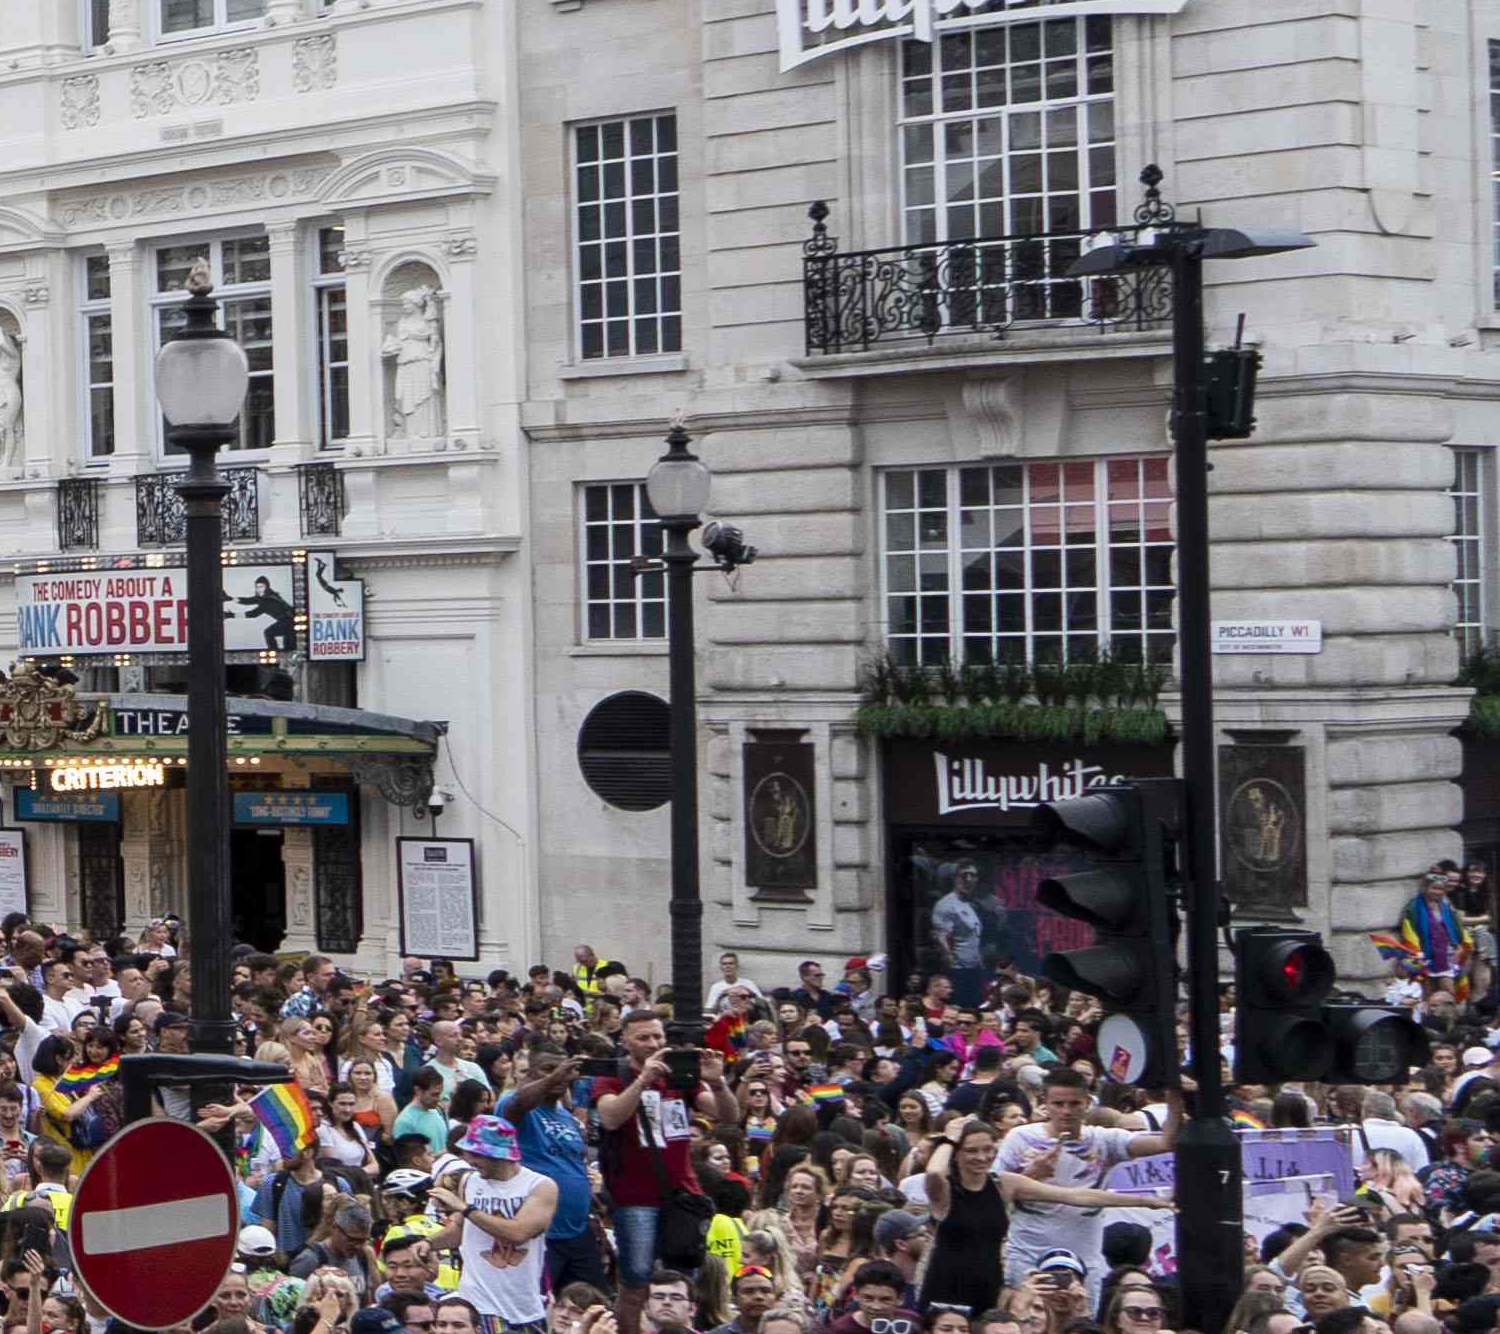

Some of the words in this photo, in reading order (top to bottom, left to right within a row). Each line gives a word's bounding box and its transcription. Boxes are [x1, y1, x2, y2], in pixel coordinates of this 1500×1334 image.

[32, 581, 49, 602] THE
[51, 579, 102, 600] COMEDY
[107, 577, 157, 599] ABOUT
[162, 575, 174, 597] A
[312, 618, 360, 642] BANK
[1220, 625, 1284, 638] PICCADILLY
[1292, 625, 1310, 638] W1
[313, 642, 360, 656] ROBBERY
[117, 712, 242, 736] THEAE
[51, 765, 164, 792] CRITERION
[1220, 1170, 1232, 1184] 7
